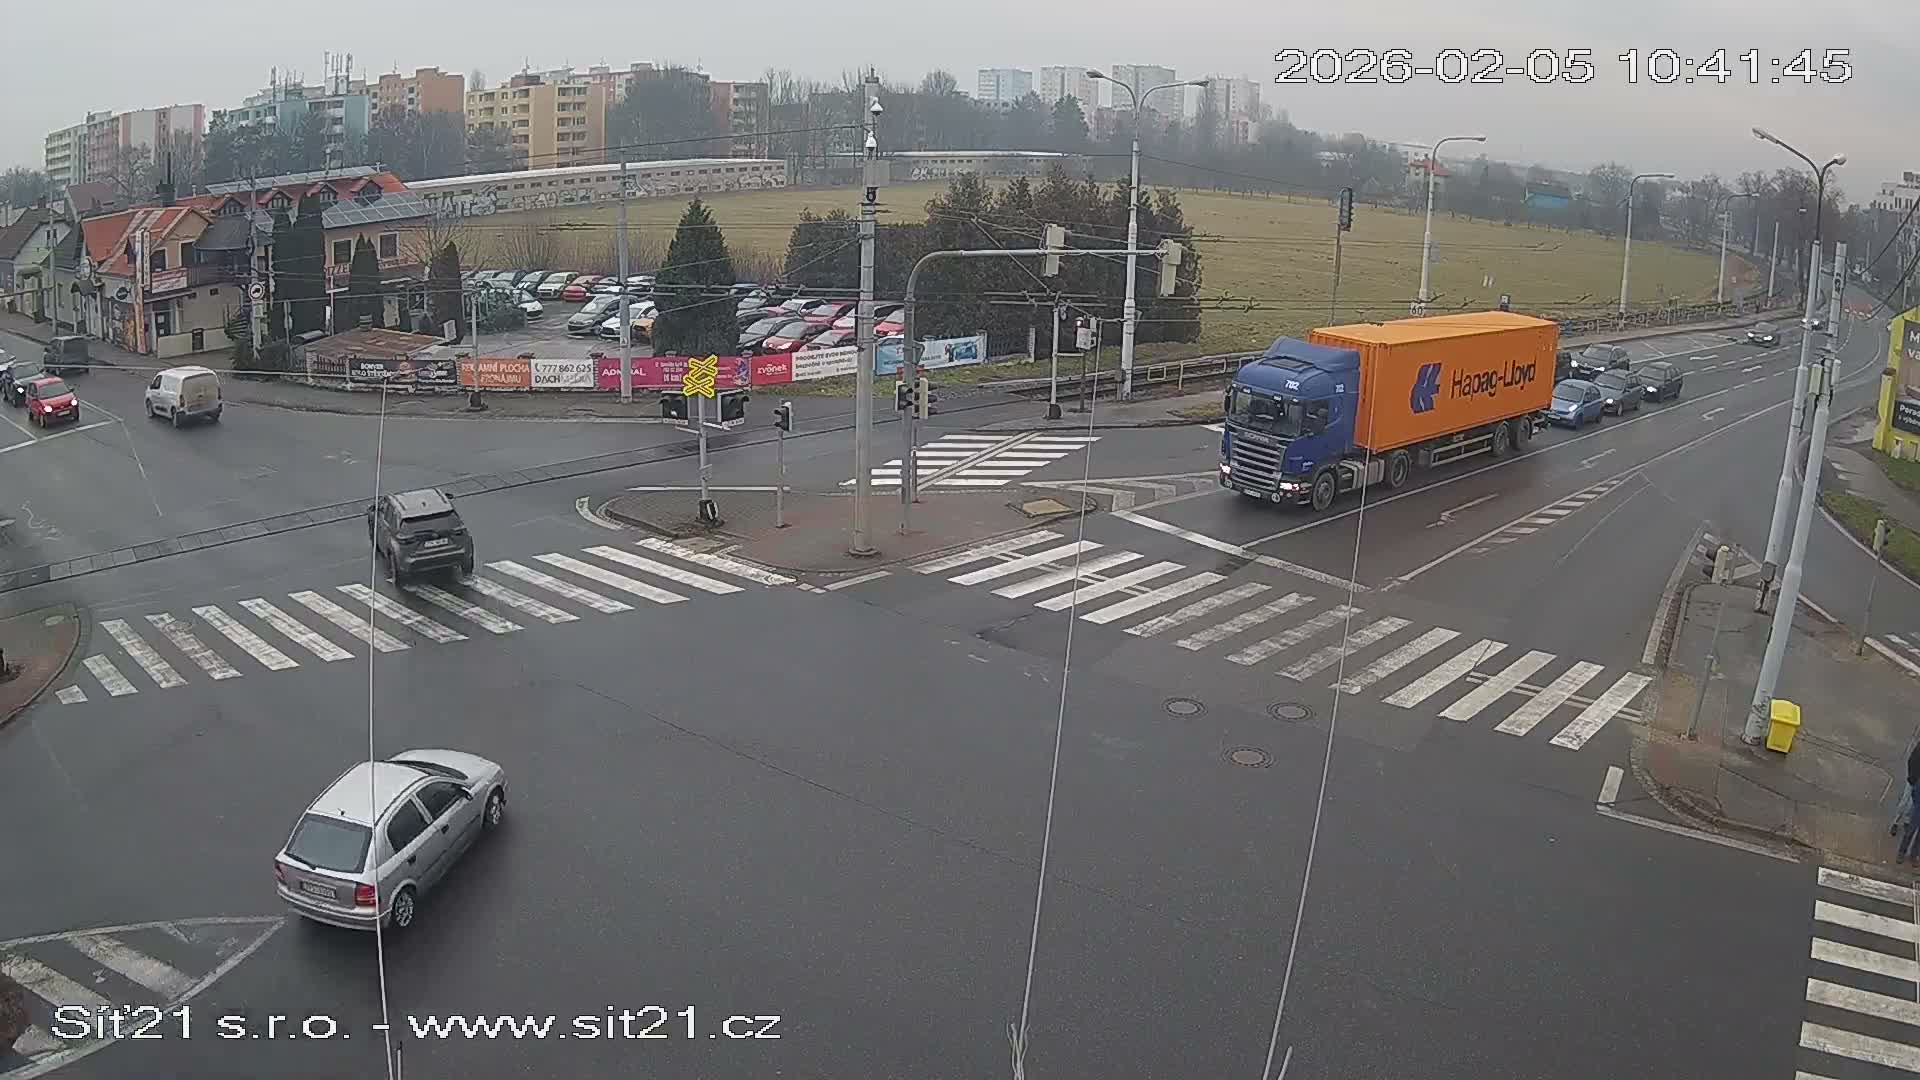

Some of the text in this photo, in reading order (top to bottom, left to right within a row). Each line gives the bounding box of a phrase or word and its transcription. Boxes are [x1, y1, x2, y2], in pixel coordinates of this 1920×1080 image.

[1411, 306, 1423, 315] 60
[542, 364, 557, 373] 777
[1450, 355, 1537, 402] Hapag-Lloyd
